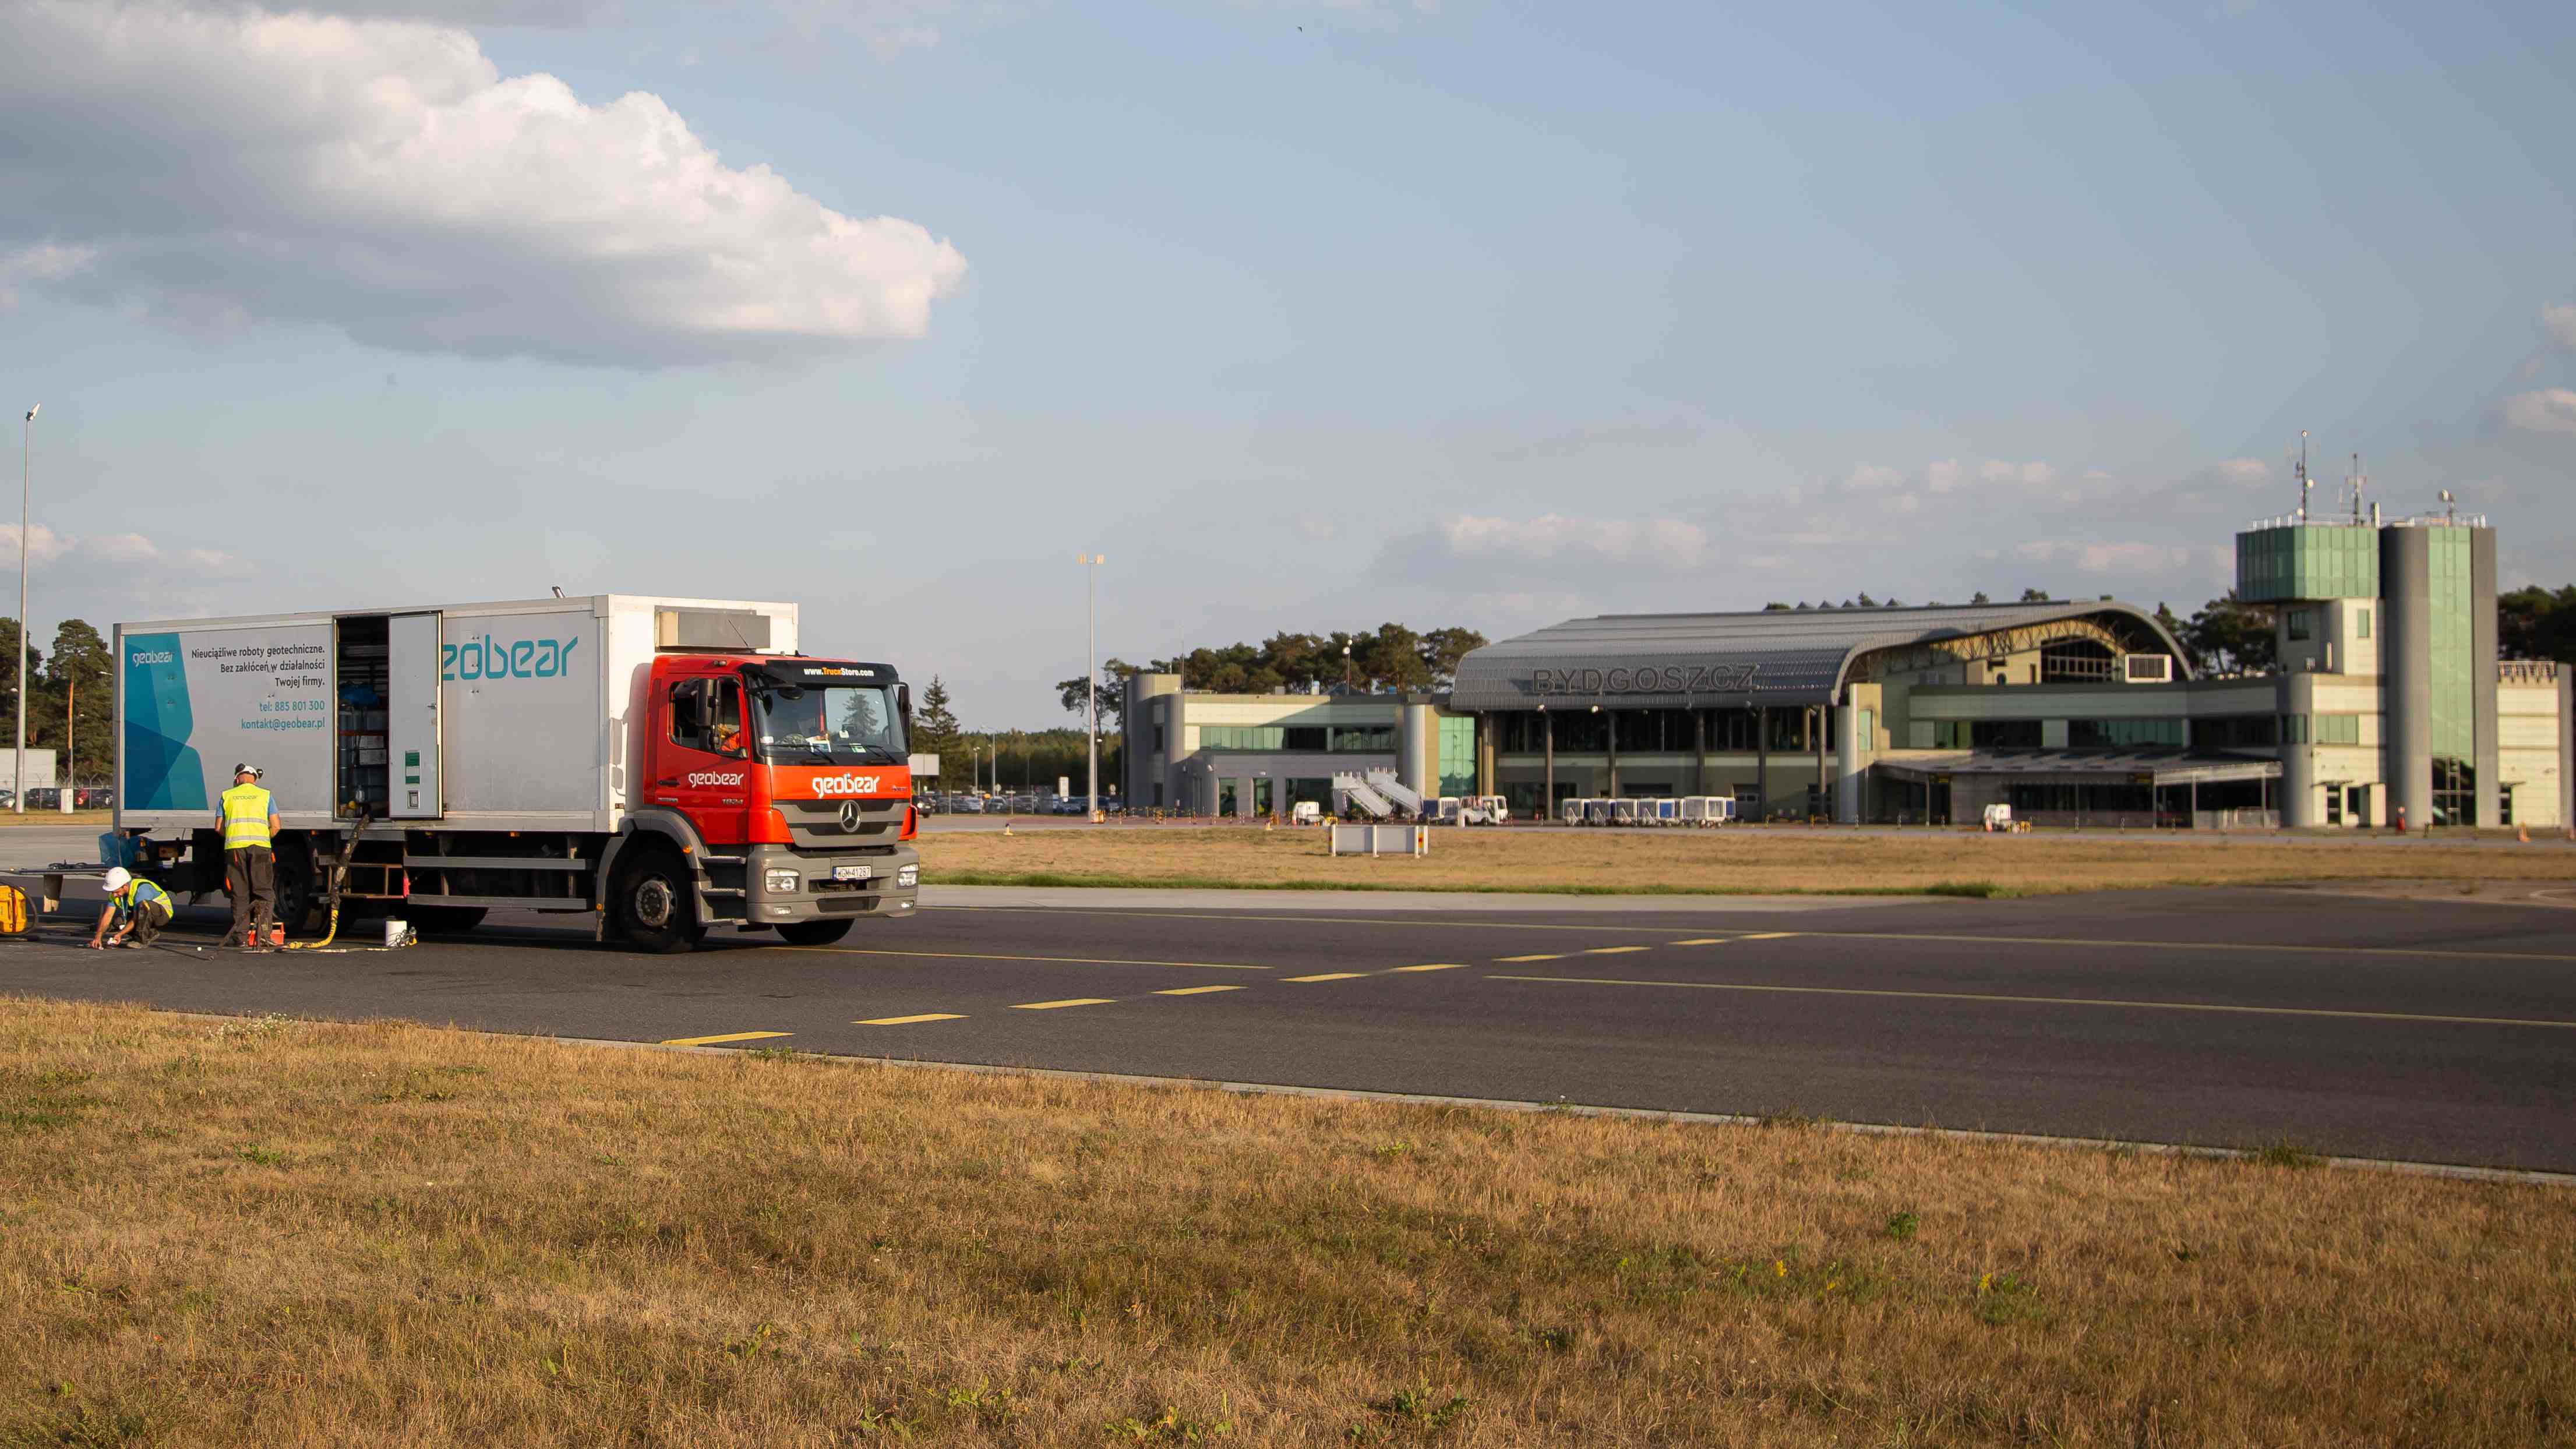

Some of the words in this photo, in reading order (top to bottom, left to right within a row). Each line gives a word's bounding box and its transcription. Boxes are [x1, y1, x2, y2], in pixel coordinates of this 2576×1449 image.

[133, 650, 173, 667] geobear
[192, 647, 237, 659] Nieuciążliwe
[239, 646, 264, 657] roboty
[267, 644, 325, 657] geotechniczne.
[442, 634, 578, 680] eobear
[220, 663, 234, 673] Bez
[235, 660, 269, 672] zakłóceń
[280, 659, 325, 670] działalności
[275, 676, 301, 688] Twojej
[302, 676, 325, 687] firmy.
[1533, 665, 1755, 694] BYDGOSZCZ
[259, 701, 273, 712] tel:
[274, 701, 290, 711] 885
[292, 701, 306, 711] 801
[309, 700, 325, 710] 300
[241, 716, 325, 731] kontakt@geobear.pl
[689, 771, 744, 787] geobear
[812, 773, 880, 798] geobear
